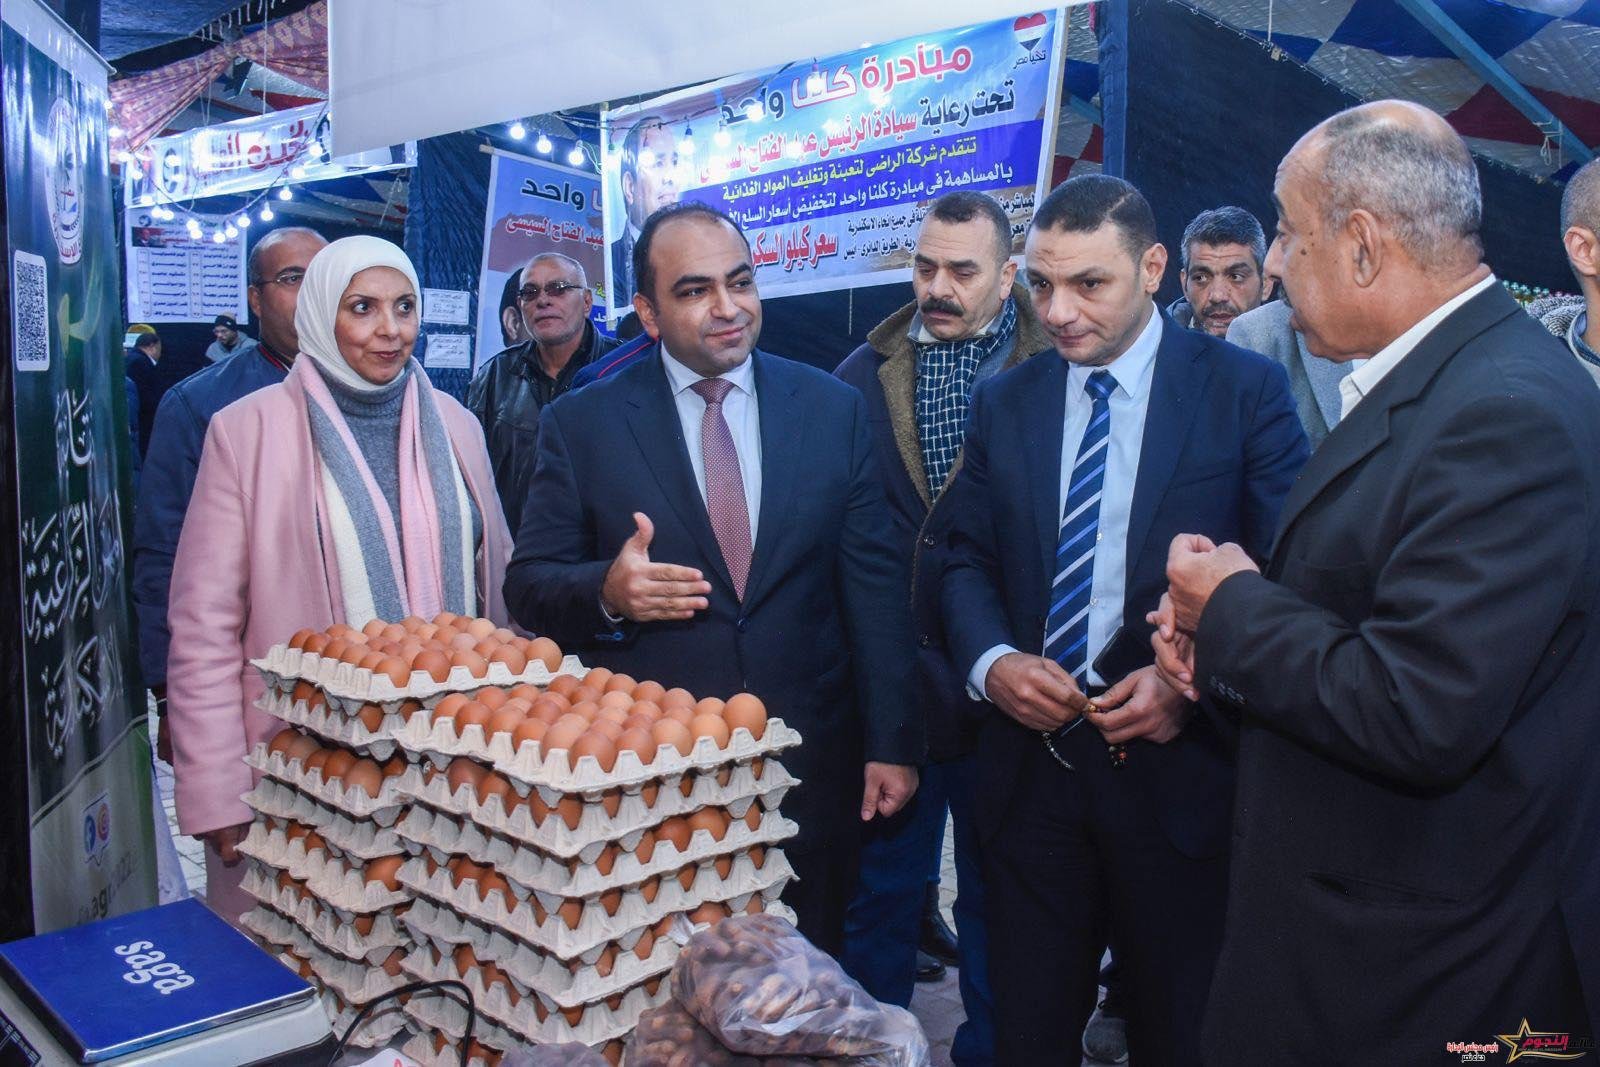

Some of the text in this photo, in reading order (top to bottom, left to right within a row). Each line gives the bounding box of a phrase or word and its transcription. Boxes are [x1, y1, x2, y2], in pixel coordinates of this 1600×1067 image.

[861, 44, 973, 93] مبادرة
[971, 79, 1015, 117] تحت
[873, 109, 917, 140] سيادة
[919, 97, 970, 134] رعاية
[819, 113, 872, 158] الرئيس
[906, 144, 938, 168] شركة
[939, 136, 978, 162] تتقدم
[791, 166, 829, 189] وتغليف
[829, 159, 865, 182] لتعبئة
[944, 162, 1013, 187] بالمساهمة
[521, 178, 585, 211] واحد
[722, 181, 761, 203] الغذائية
[763, 174, 790, 196] المواد
[868, 181, 888, 200] كلنا
[890, 178, 924, 200] مبادرة
[792, 192, 837, 218] لتخفيض
[839, 189, 867, 207] واحد
[741, 205, 765, 229] السلع
[551, 220, 585, 242] الفتاح
[751, 224, 838, 271] سعر كيلو السكر
[113, 940, 195, 995] saga
